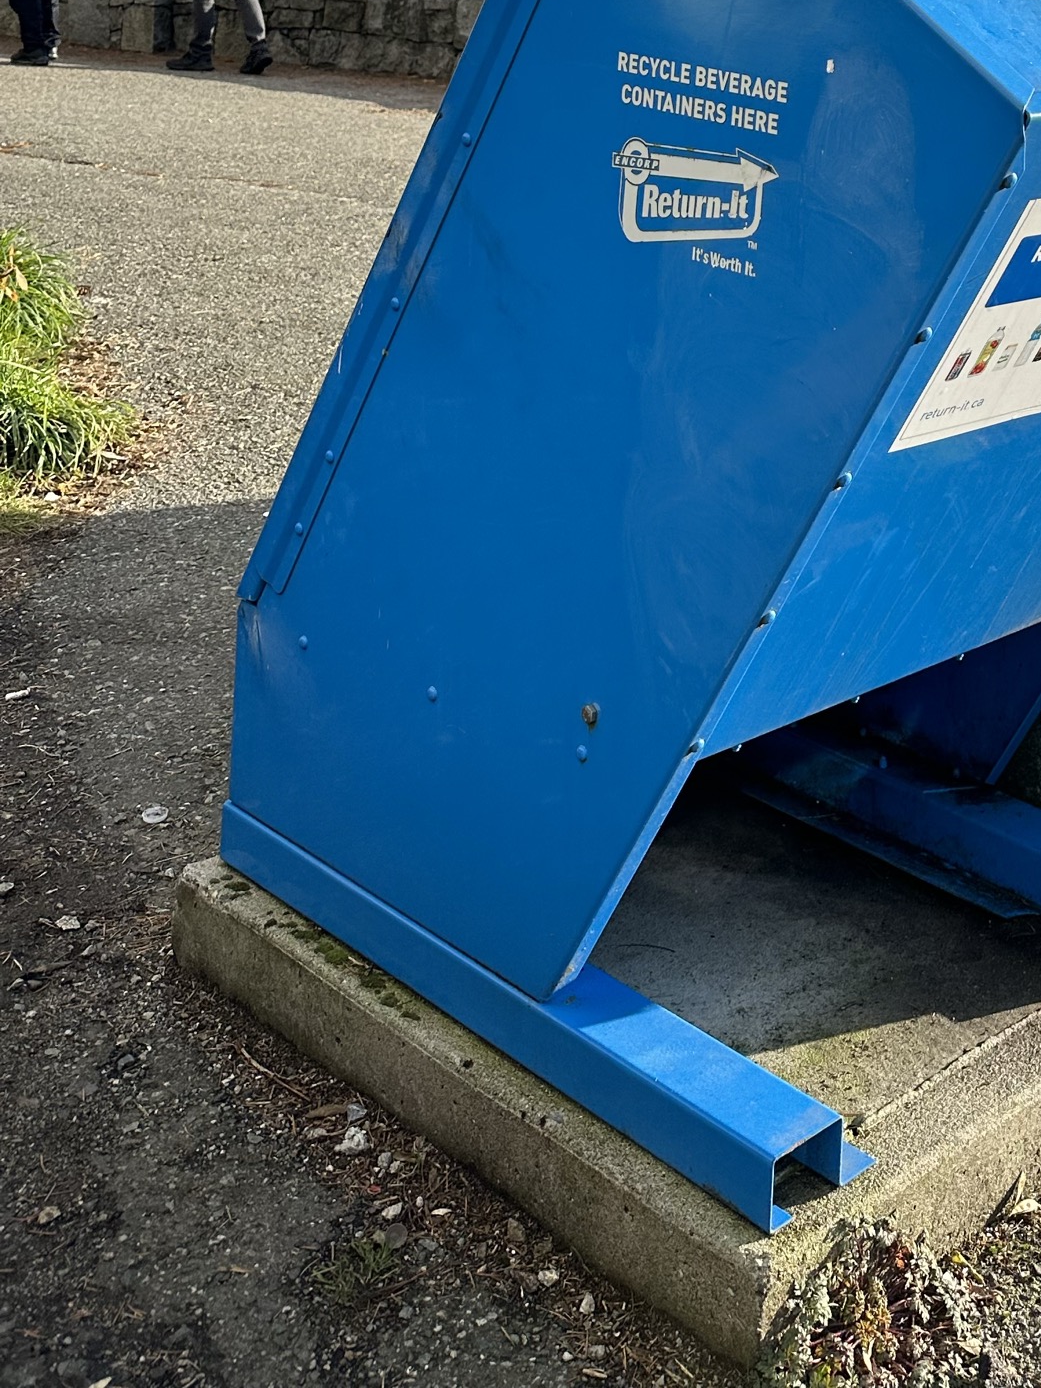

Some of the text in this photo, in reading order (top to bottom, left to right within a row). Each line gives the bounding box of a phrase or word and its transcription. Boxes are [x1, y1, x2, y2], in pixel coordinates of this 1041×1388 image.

[617, 51, 789, 103] RECYCLE BEVERAGE
[621, 84, 780, 135] CONTAINERS HERE
[614, 155, 659, 171] ENCORP
[641, 184, 749, 219] Return-It
[691, 246, 757, 277] It's Worth It.
[919, 397, 985, 421] return-it.ca
